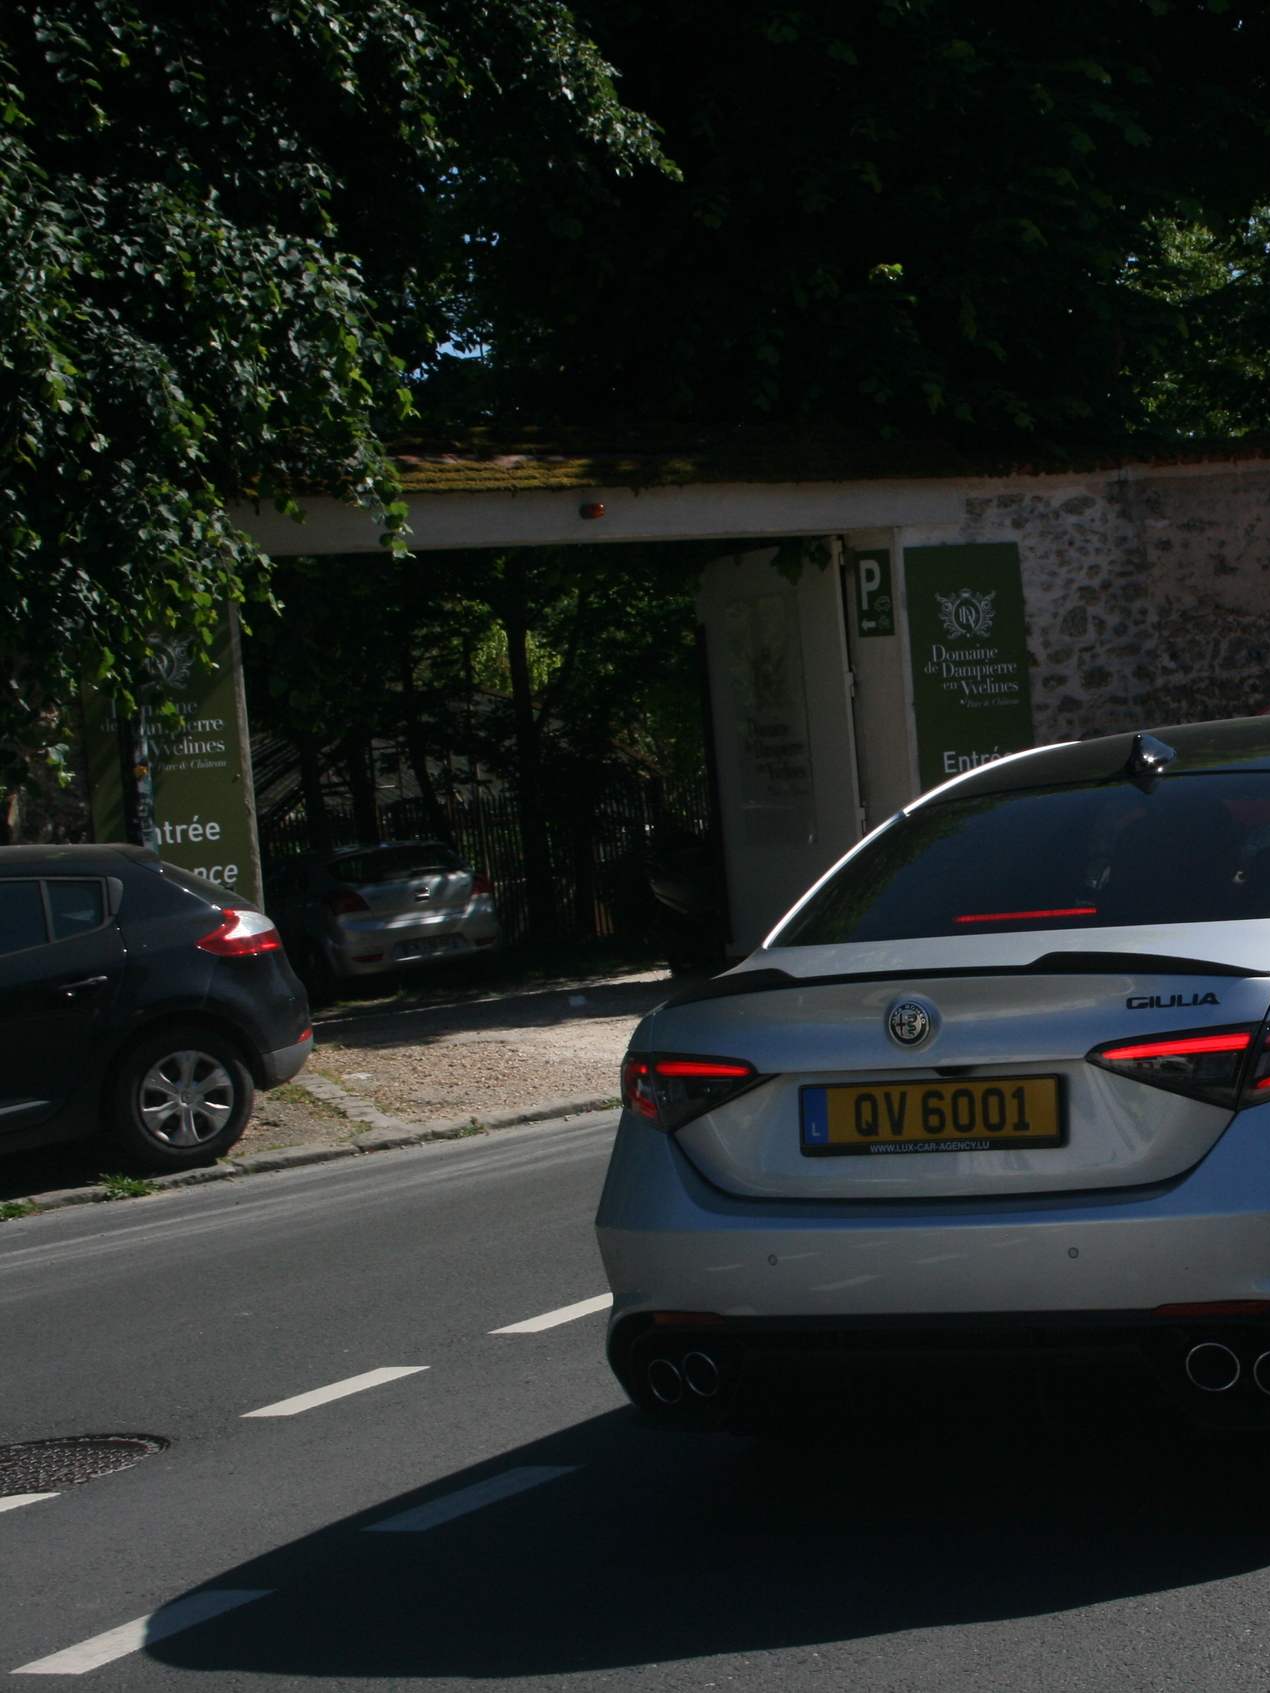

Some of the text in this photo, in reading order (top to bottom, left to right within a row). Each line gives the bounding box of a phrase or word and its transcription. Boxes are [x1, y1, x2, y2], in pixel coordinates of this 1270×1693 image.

[859, 559, 881, 611] P
[932, 643, 998, 662] Domaine
[924, 659, 1017, 681] de Dampierre
[190, 759, 227, 769] Château
[943, 746, 1012, 773] Entré
[154, 815, 221, 845] ntrée
[1126, 992, 1221, 1010] GIULIA
[811, 1086, 1030, 1137] L QV 6001
[870, 1140, 990, 1153] WWW.LUX-CAR-AGENCY.LU
